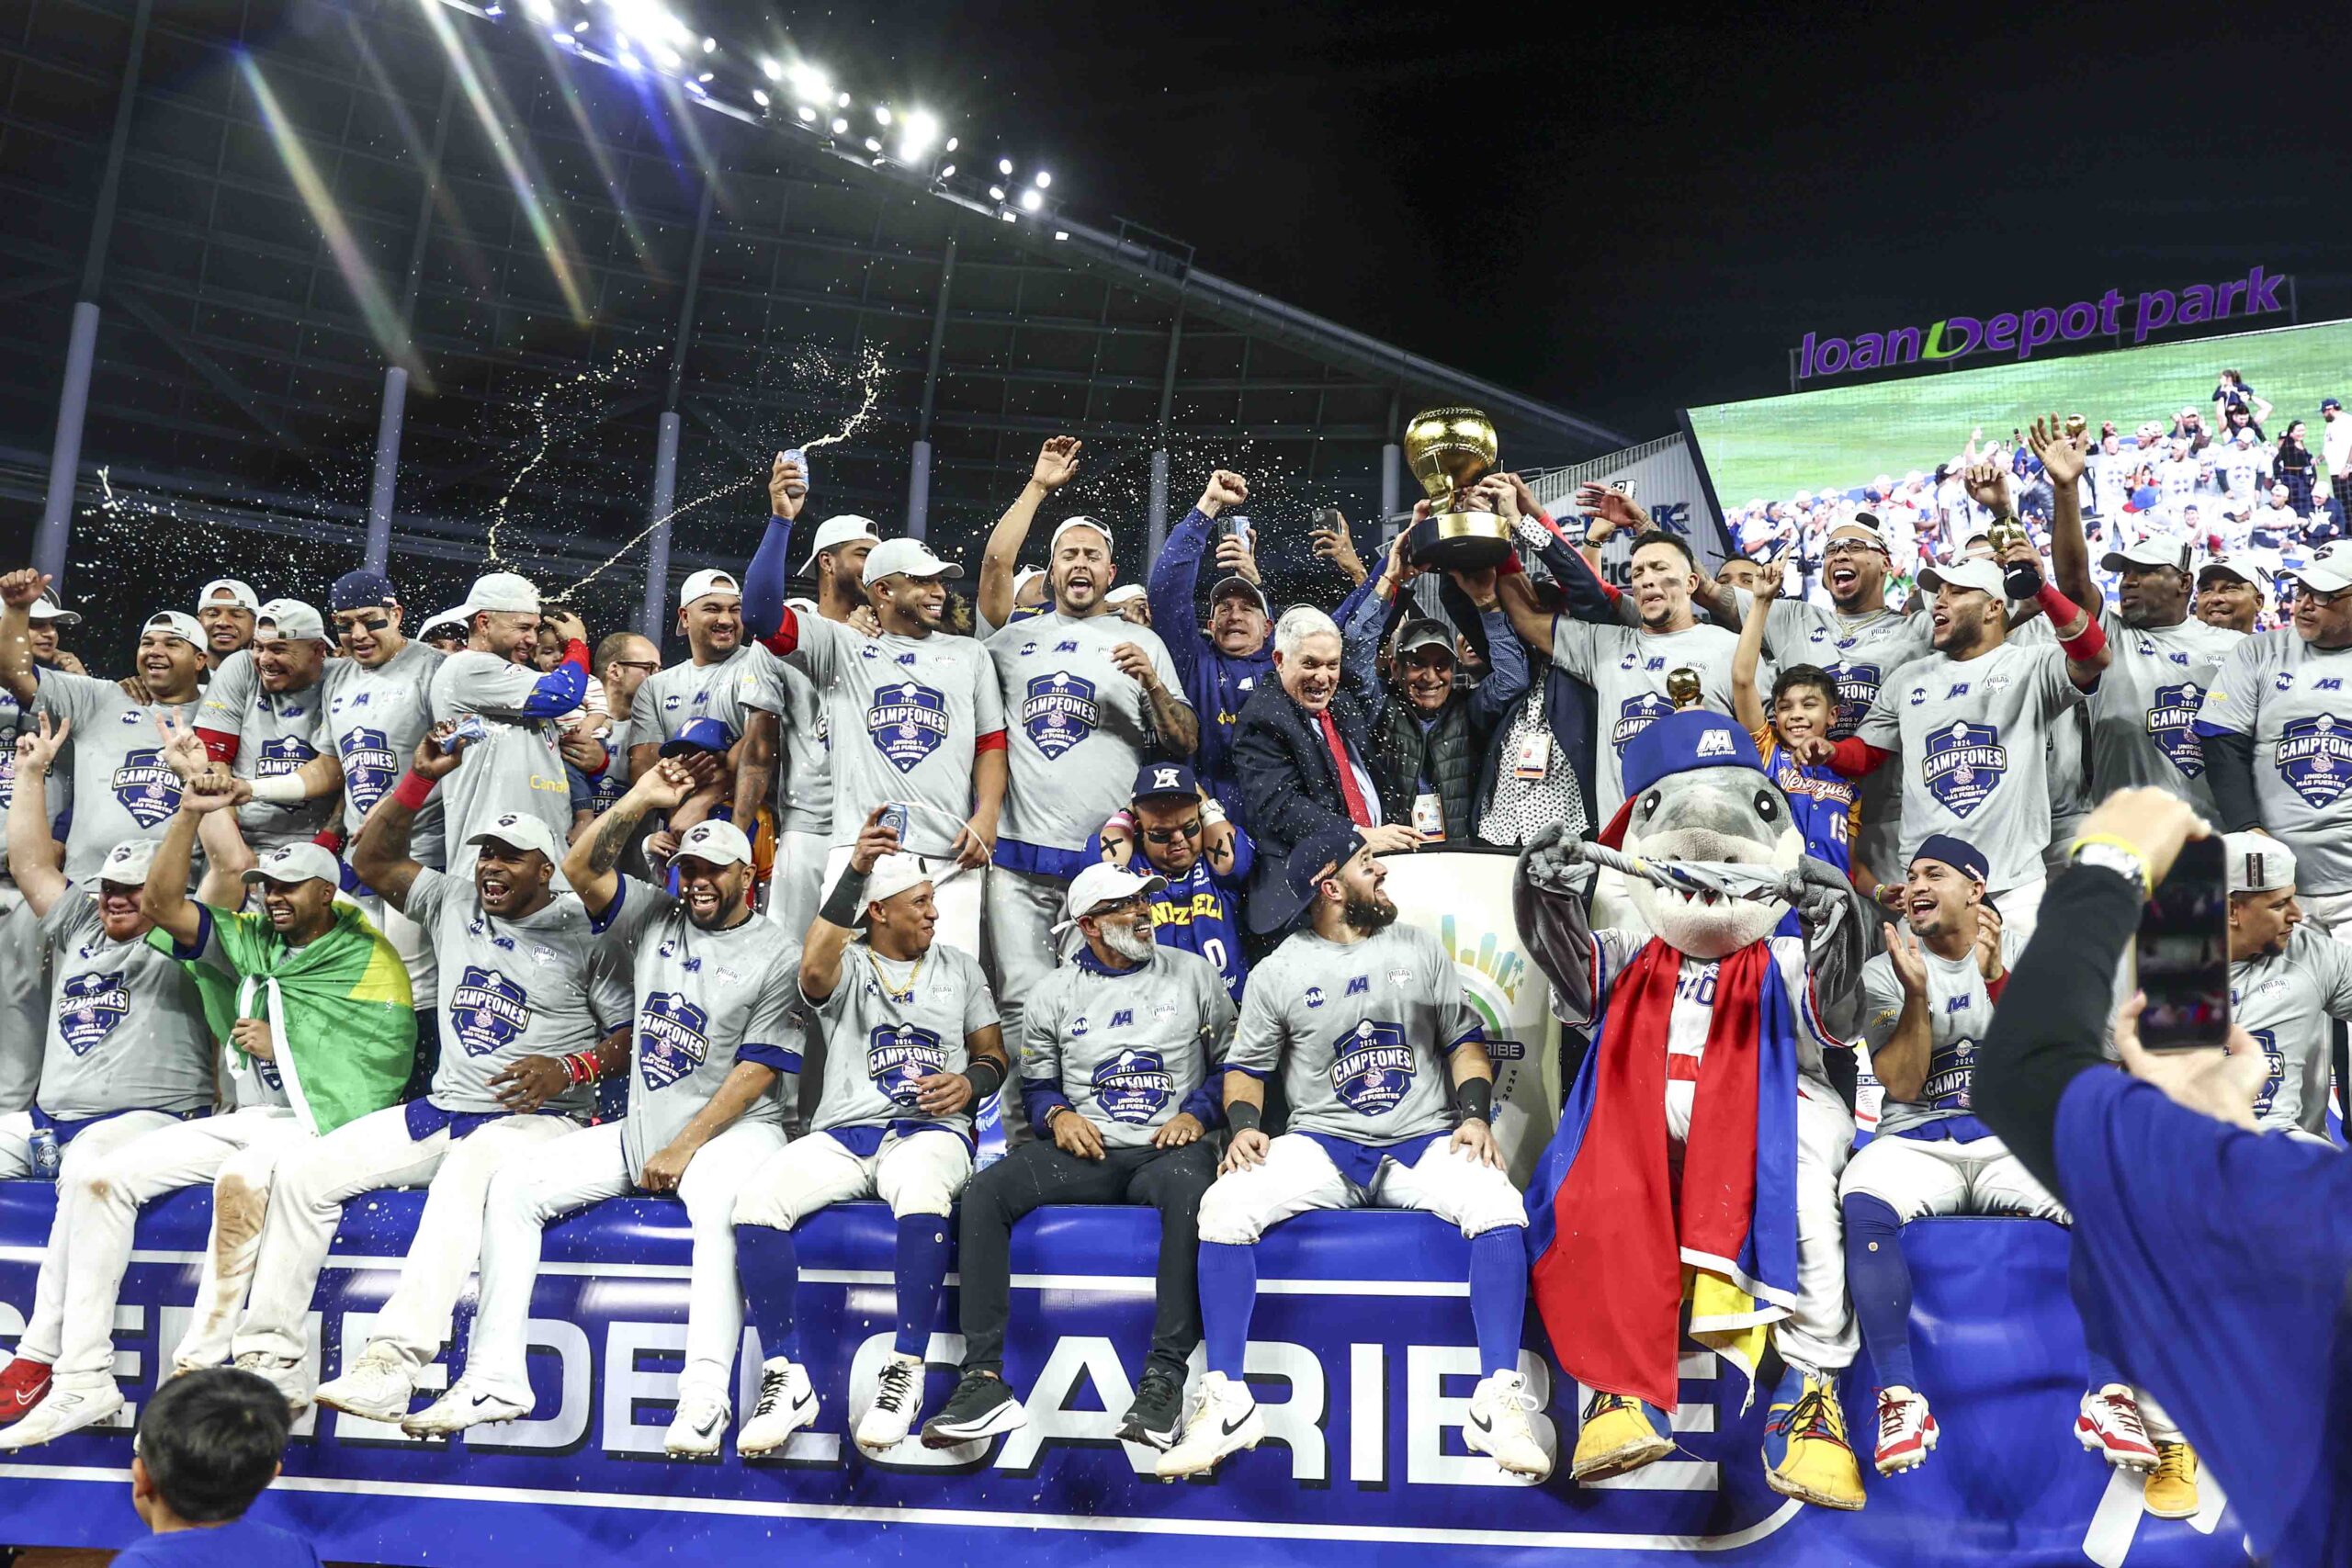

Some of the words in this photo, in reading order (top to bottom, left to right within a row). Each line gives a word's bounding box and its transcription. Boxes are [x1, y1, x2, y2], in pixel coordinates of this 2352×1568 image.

[1799, 288, 2124, 378] loanDepot
[2134, 265, 2286, 344] park
[663, 696, 682, 709] PAN
[1909, 690, 1928, 703] PAN
[2180, 700, 2198, 708] 2024
[1025, 697, 1096, 721] CAMPEONES
[870, 707, 945, 732] CAMPEONES
[2151, 709, 2196, 728] CAMPE
[1952, 739, 1971, 748] 2024
[341, 751, 394, 772] AMPEONES
[1926, 749, 2003, 778] CAMPEONES
[1949, 784, 1975, 795] UNIDOS
[2312, 780, 2346, 788] FUERTES
[1959, 789, 1988, 799] FUERTES
[1829, 810, 1849, 845] 15
[1302, 990, 1327, 1007] PAN
[456, 990, 526, 1025] CAMPEONES
[1069, 1020, 1091, 1033] PAN
[1359, 1038, 1378, 1048] 2024
[870, 1047, 946, 1072] CAMPEONES
[1333, 1049, 1412, 1083] CAMPEONES
[1954, 1058, 1974, 1066] 2024
[1104, 1076, 1170, 1091] PEONES
[1502, 1068, 1518, 1100] 2024
[1926, 1070, 1973, 1097] CAMPE
[1367, 1092, 1400, 1101] FUERTES
[1125, 1104, 1157, 1112] FUERTES
[462, 1316, 841, 1462] DEL
[848, 1331, 1720, 1491] CARIBE
